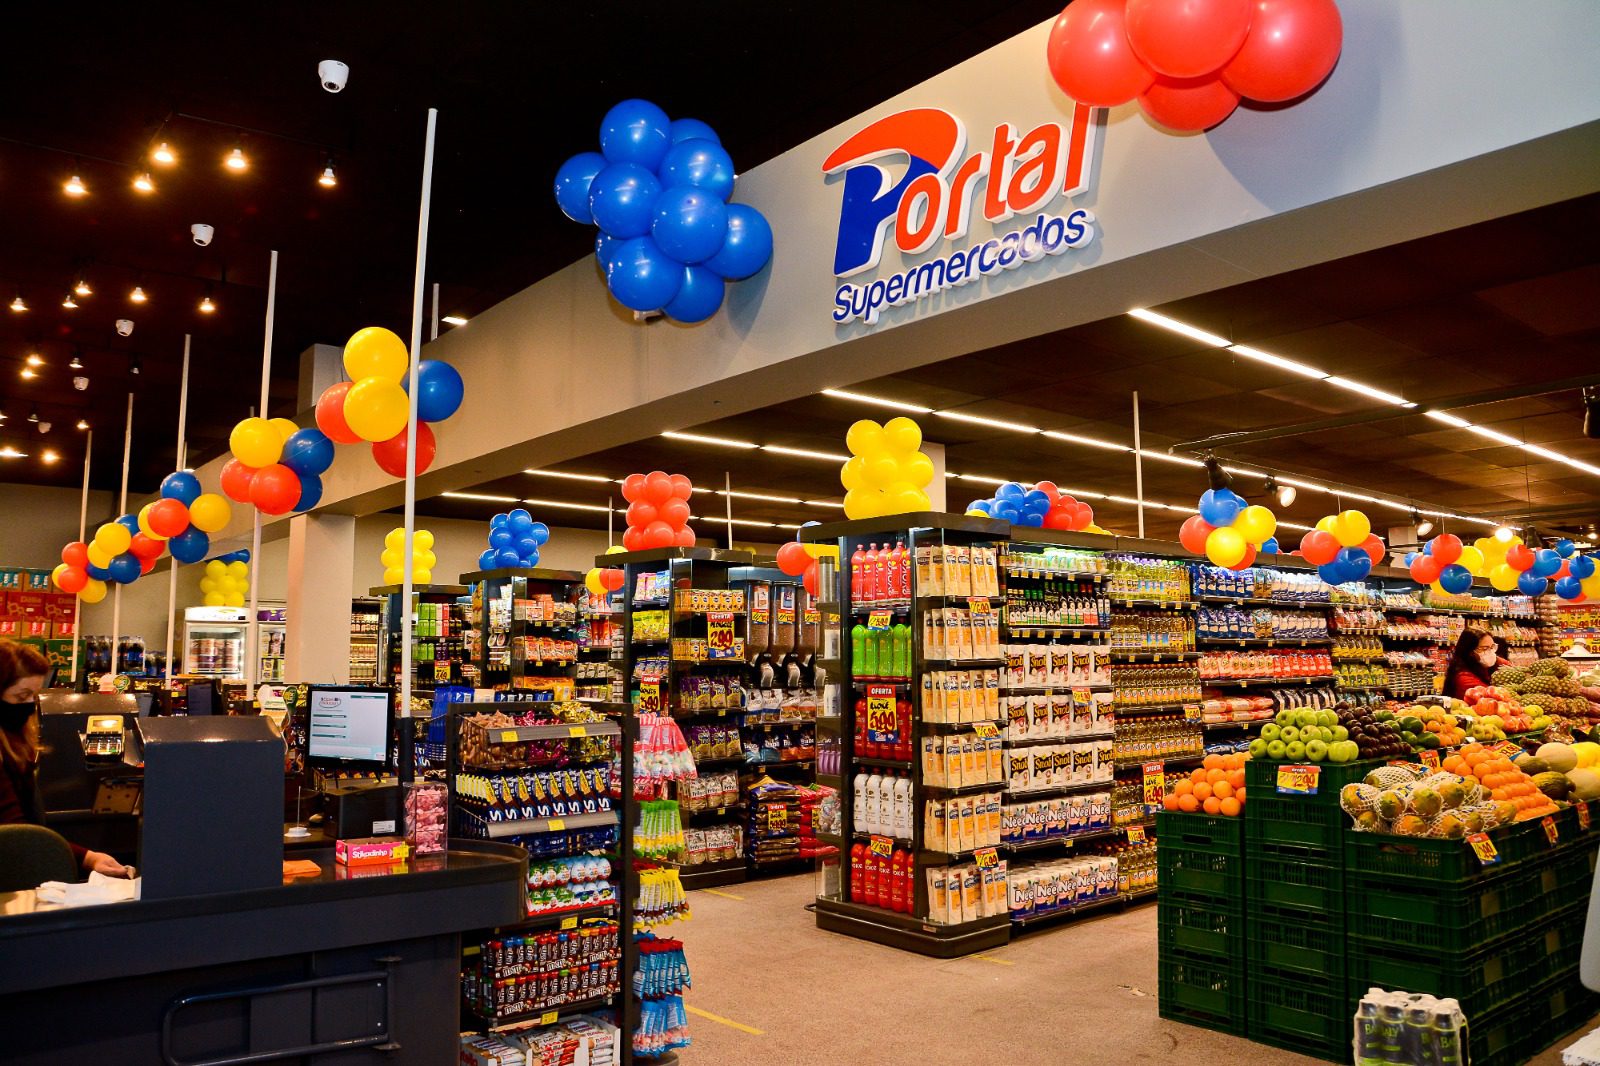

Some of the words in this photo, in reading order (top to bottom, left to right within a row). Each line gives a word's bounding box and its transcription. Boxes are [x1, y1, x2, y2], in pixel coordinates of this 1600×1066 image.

[822, 101, 1096, 278] Portal
[832, 209, 1094, 324] Supermercados
[871, 687, 893, 695] OFERTA
[1146, 764, 1161, 772] OFERTA
